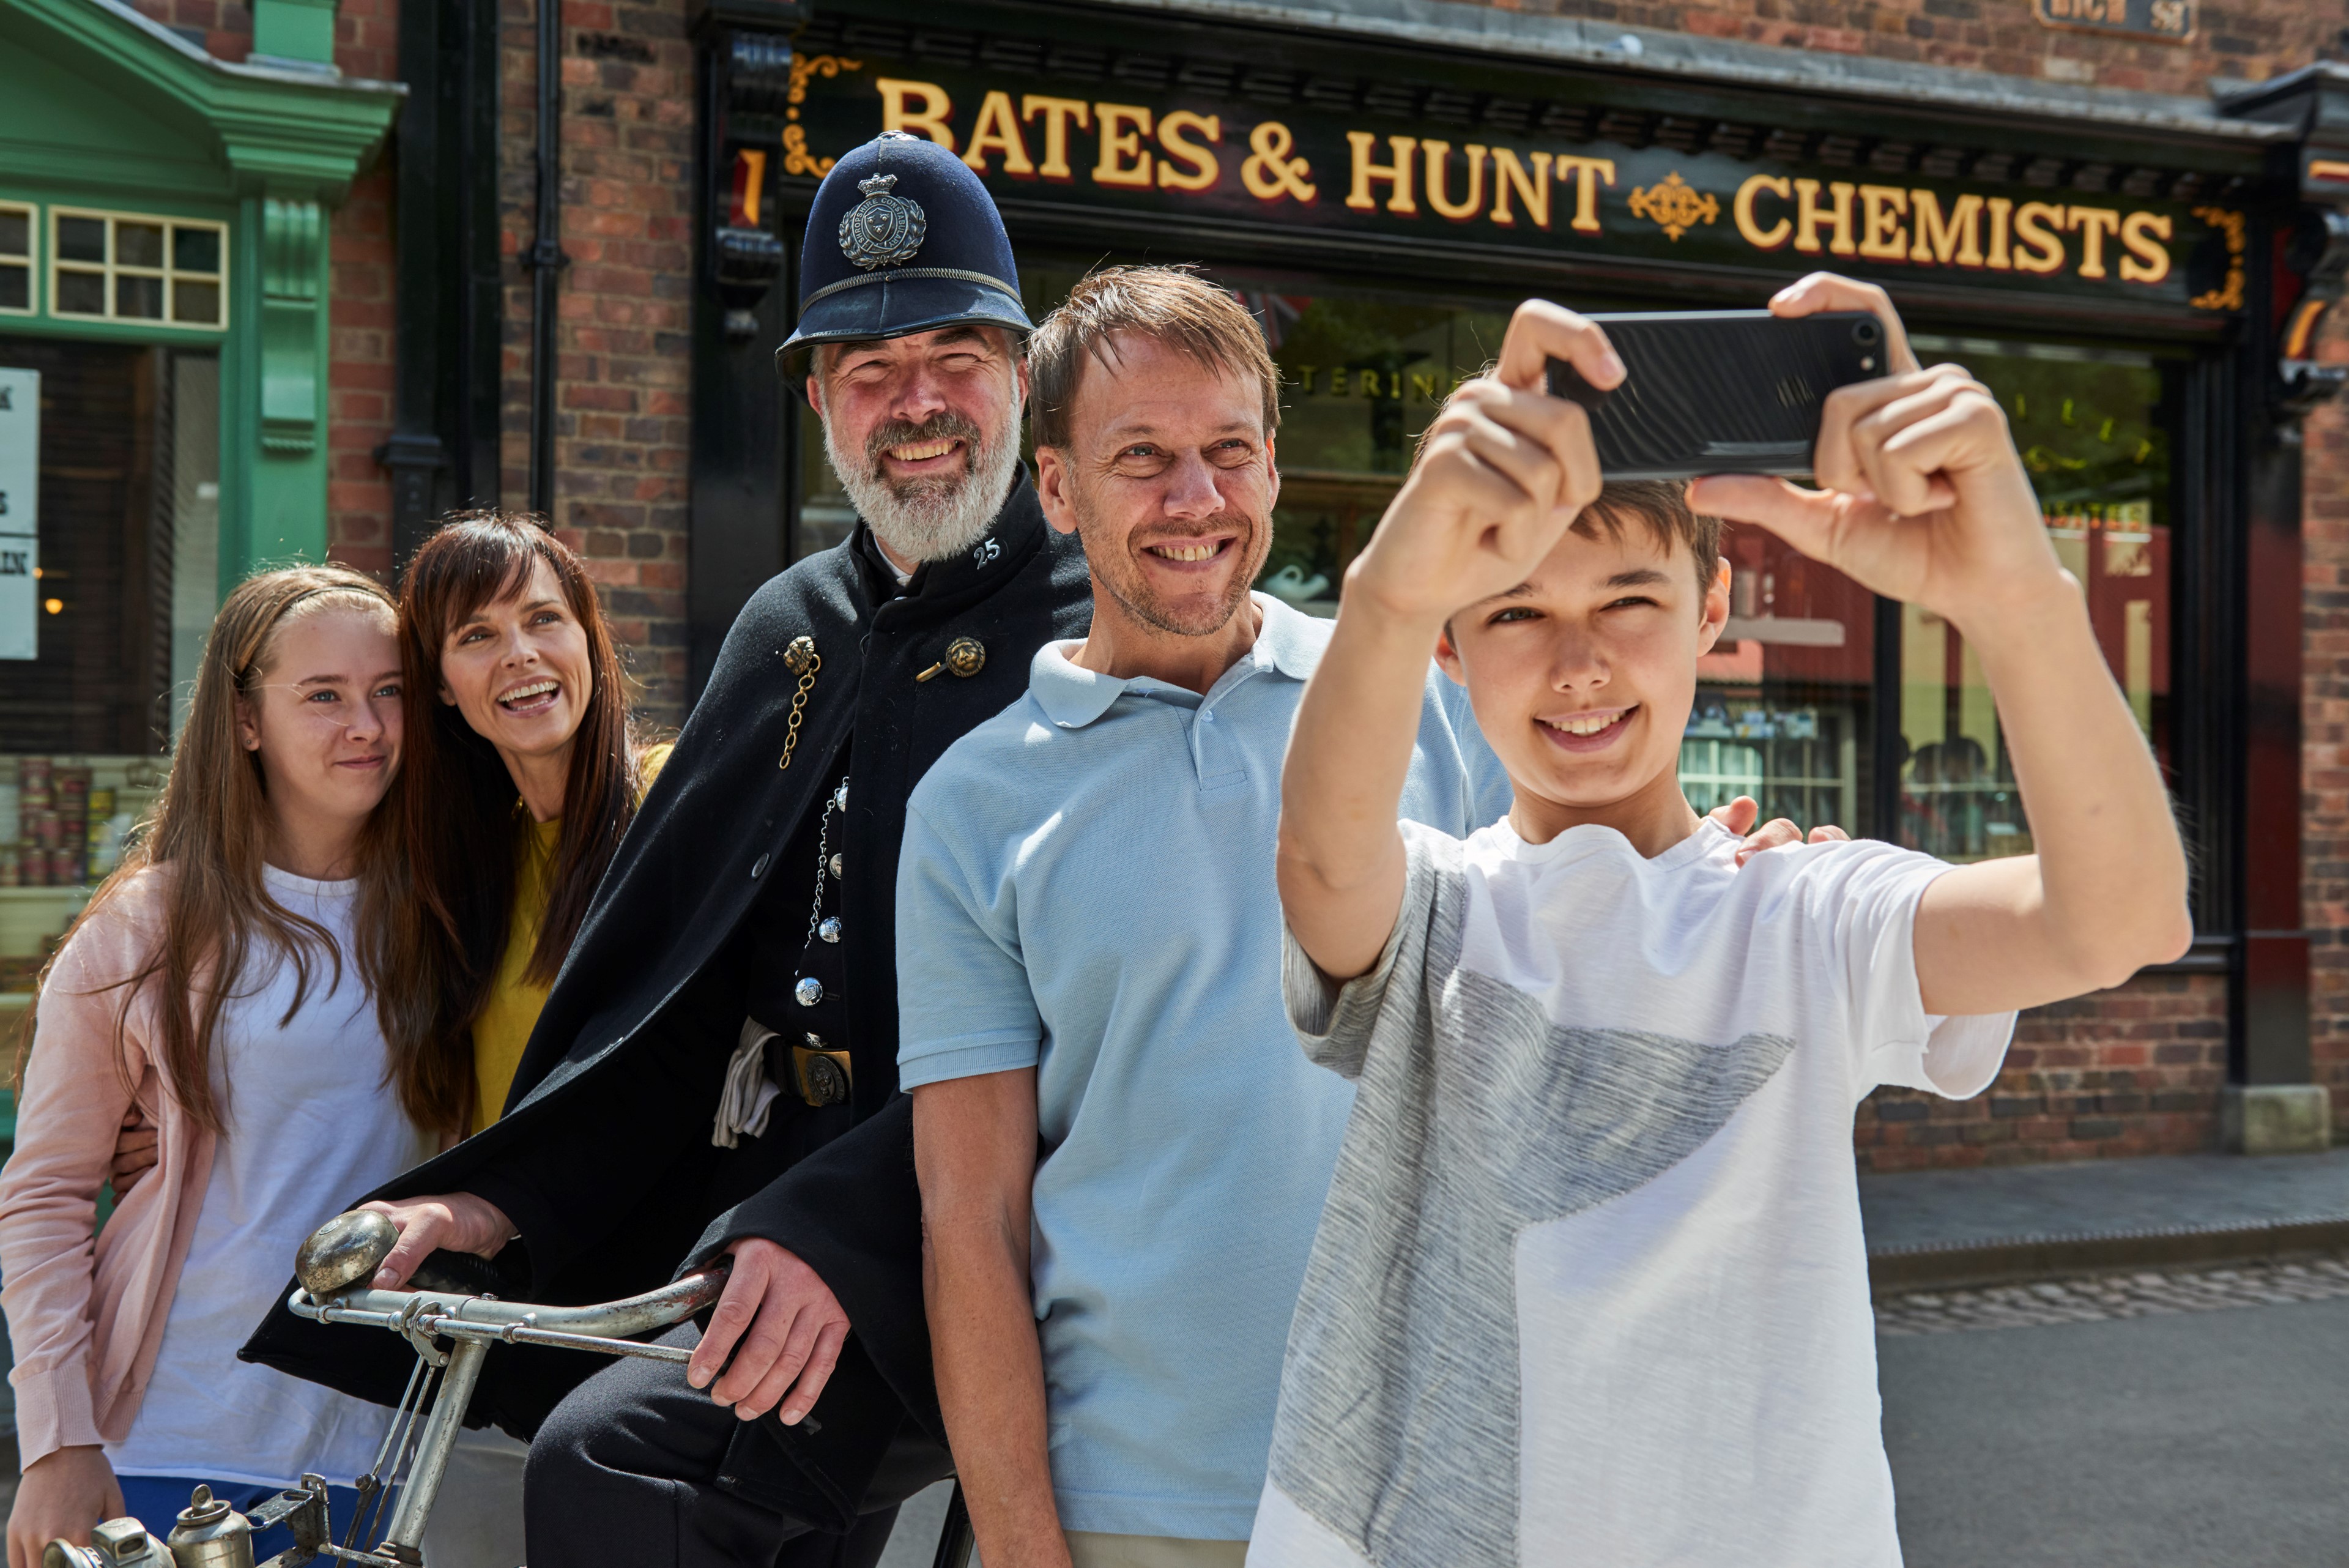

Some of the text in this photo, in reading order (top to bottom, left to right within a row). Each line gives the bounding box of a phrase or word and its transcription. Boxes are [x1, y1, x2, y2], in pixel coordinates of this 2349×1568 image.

[876, 76, 2173, 284] BATES & HUNT CHEMISTS
[854, 198, 905, 248] SHROPSHIRE CONSTABULARY
[1296, 365, 1461, 403] TERIN
[974, 537, 1001, 570] 25
